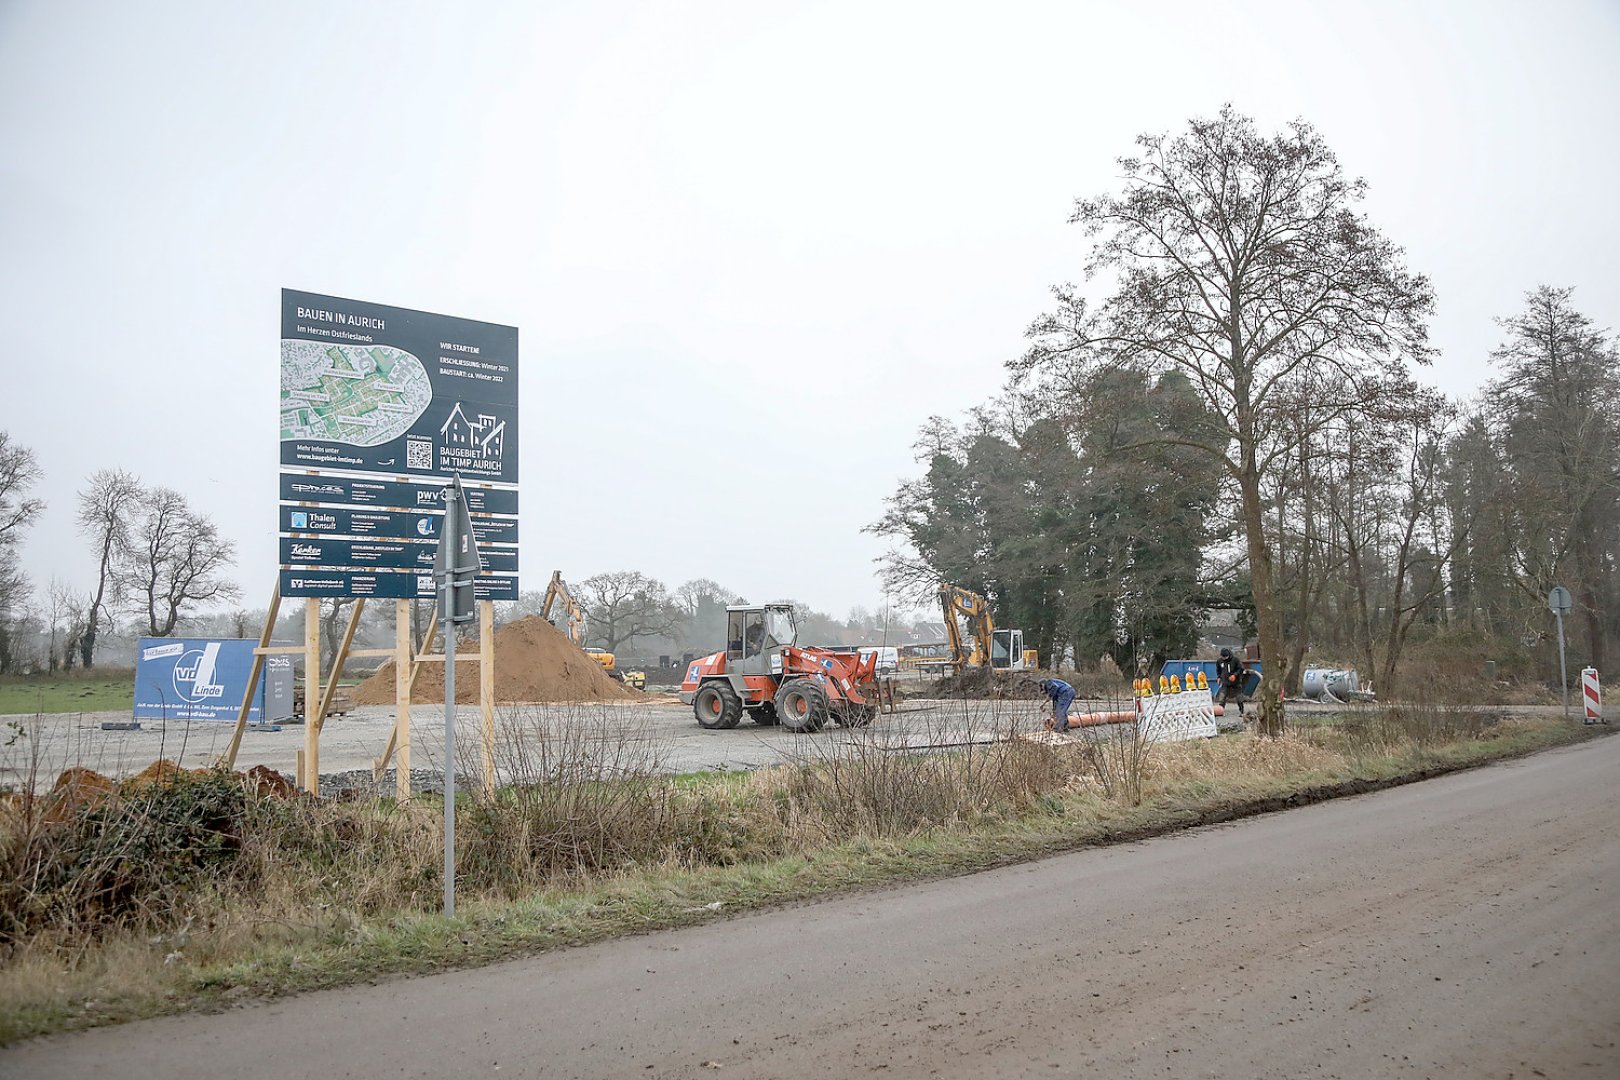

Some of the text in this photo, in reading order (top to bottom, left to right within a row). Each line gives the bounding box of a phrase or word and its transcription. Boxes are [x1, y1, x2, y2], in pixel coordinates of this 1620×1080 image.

[298, 307, 385, 329] BAUEN IN AURICH
[307, 326, 330, 336] Herzen
[331, 330, 373, 342] Ostfrieslands
[440, 446, 481, 458] BAUGEBIET
[440, 456, 501, 470] IM TIMP AURICH
[417, 490, 439, 504] pwv
[310, 513, 335, 522] Thalen
[310, 521, 336, 530] Consult
[194, 686, 220, 695] Linde
